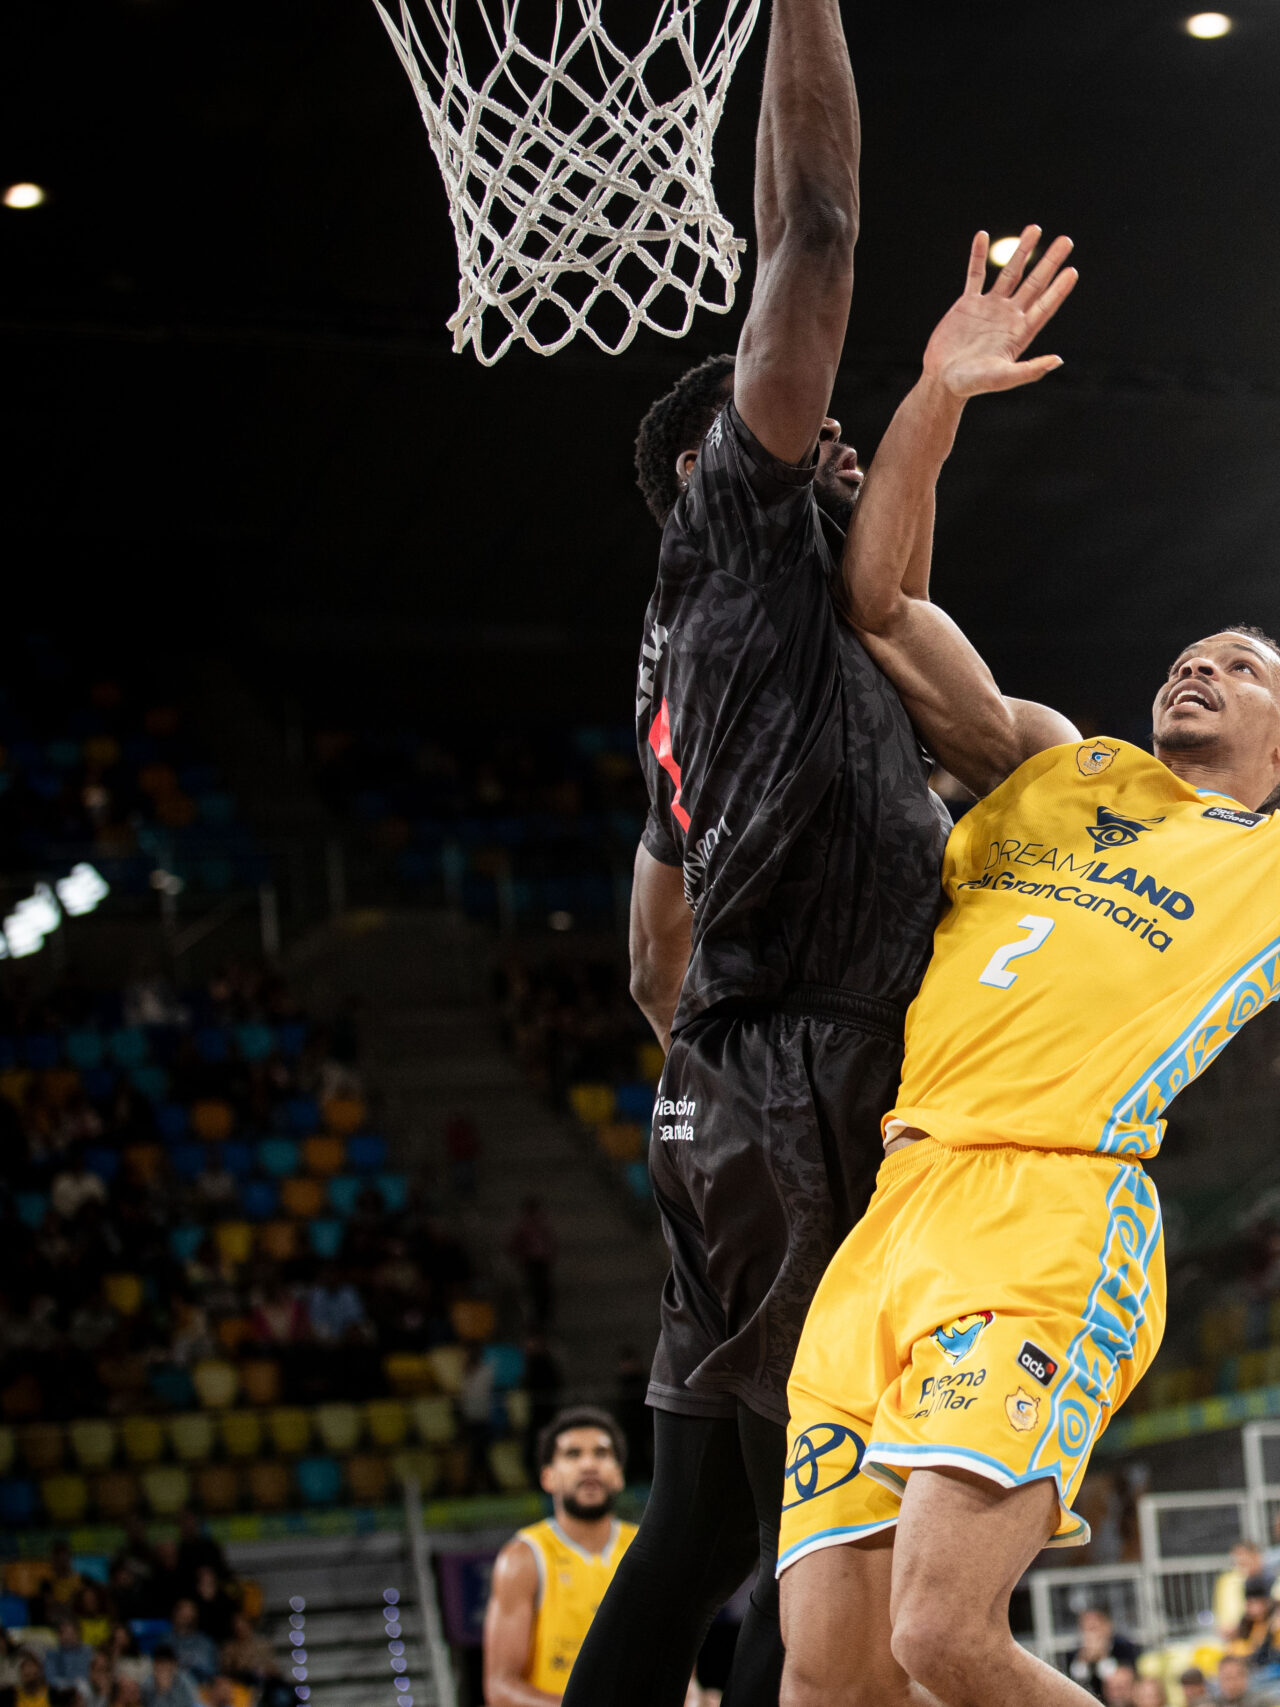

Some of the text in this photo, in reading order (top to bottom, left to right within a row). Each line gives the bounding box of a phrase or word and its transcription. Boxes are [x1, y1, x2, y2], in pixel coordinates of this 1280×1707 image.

[984, 839, 1195, 921] DREAMLAND
[979, 914, 1055, 989] 2
[1021, 1353, 1045, 1379] acb
